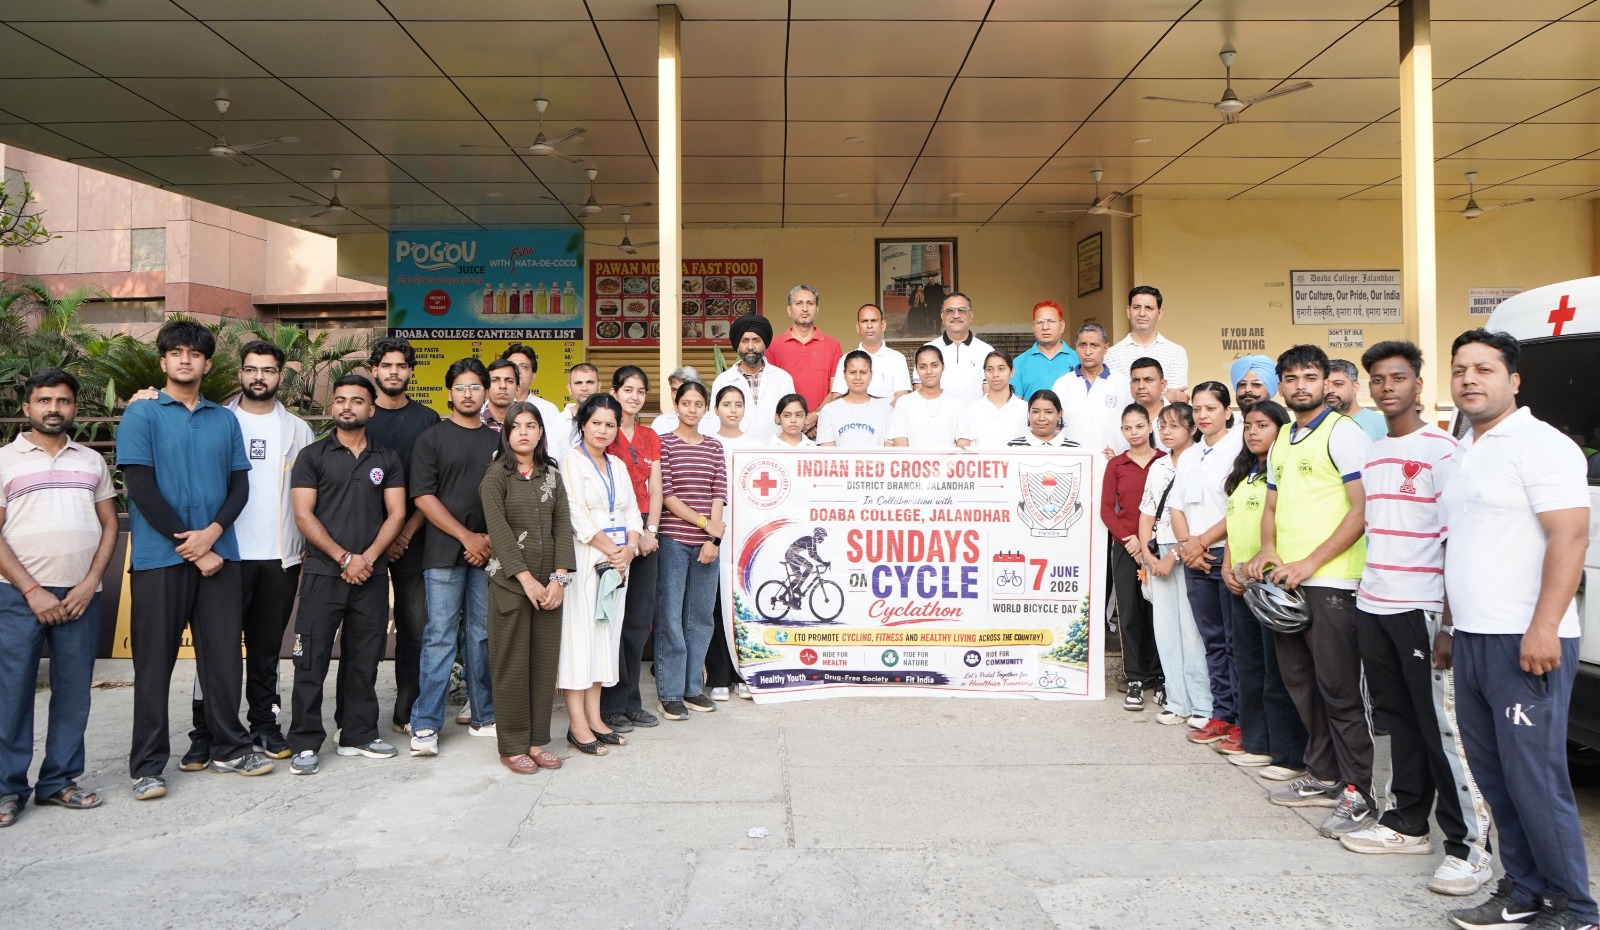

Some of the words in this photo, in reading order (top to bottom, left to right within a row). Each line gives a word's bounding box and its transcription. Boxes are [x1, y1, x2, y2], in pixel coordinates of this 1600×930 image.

[489, 259, 511, 267] WITH
[515, 259, 577, 267] NATA-DE-COCO
[595, 262, 639, 275] PAWAN
[642, 262, 690, 275] MISA
[692, 262, 722, 275] FAST
[725, 262, 758, 275] FOOD
[458, 266, 485, 274] JUICE
[1310, 274, 1331, 282] Doaba
[1362, 273, 1394, 283] Jalandhar
[1295, 290, 1307, 300] Our
[1309, 290, 1334, 302] Culture,
[1336, 290, 1348, 300] Our
[1350, 290, 1368, 302] Pride,
[1371, 290, 1382, 300] Our
[1384, 290, 1400, 300] India
[1296, 306, 1312, 318] हमारी
[1336, 308, 1351, 318] हमारा
[1366, 308, 1380, 318] हमारा
[395, 330, 429, 338] DOABA
[431, 330, 475, 338] COLLEGE
[476, 330, 523, 338] CANTEEN
[526, 330, 552, 338] RATE
[555, 330, 576, 338] LIST
[1221, 328, 1229, 337] IF
[1230, 328, 1247, 337] YOU
[1249, 328, 1264, 336] ARE
[1222, 340, 1266, 350] WAITING
[797, 460, 849, 478] INDIAN
[855, 460, 885, 478] RED
[890, 460, 940, 478] CROSS
[946, 460, 1010, 478] SOCIETY
[847, 481, 884, 490] DISTRICT
[887, 481, 924, 492] BRANCH,
[926, 482, 975, 490] JALANDHAR
[862, 495, 873, 506] In
[876, 495, 934, 506] Collaboration
[935, 496, 953, 505] with
[1026, 498, 1046, 522] COLLEGE
[1054, 492, 1077, 522] JALANDHAR
[810, 508, 856, 522] DOABA
[860, 508, 925, 524] COLLEGE,
[930, 509, 1010, 522] JALANDHAR
[846, 529, 980, 564] SUNDAYS
[1030, 558, 1048, 590] 7
[1050, 566, 1079, 577] JUNE
[849, 572, 868, 588] ON
[872, 565, 979, 599] CYCLE
[1050, 581, 1078, 592] 2026
[868, 600, 963, 624] Cyclathon
[993, 604, 1021, 613] WORLD
[1024, 604, 1058, 613] BICYCLE
[1062, 605, 1077, 614] DAY
[794, 633, 806, 642] (TO
[808, 633, 839, 642] PROMOTE
[876, 633, 903, 642] FITNESS
[906, 634, 918, 642] AND
[920, 634, 951, 642] HEALTHY
[954, 634, 977, 642] LIVING
[979, 634, 1000, 642] ACROSS
[1002, 634, 1013, 642] THE
[1014, 633, 1044, 642] COUNTRY)
[986, 658, 1023, 666] COMMUNITY
[760, 675, 785, 685] Healthy
[786, 674, 806, 682] Youth
[824, 674, 860, 682] Drug-Free
[863, 675, 889, 683] Society
[917, 676, 934, 684] India
[1019, 671, 1028, 679] for
[968, 679, 1000, 687] Healthier
[1002, 679, 1033, 687] Tomorrow
